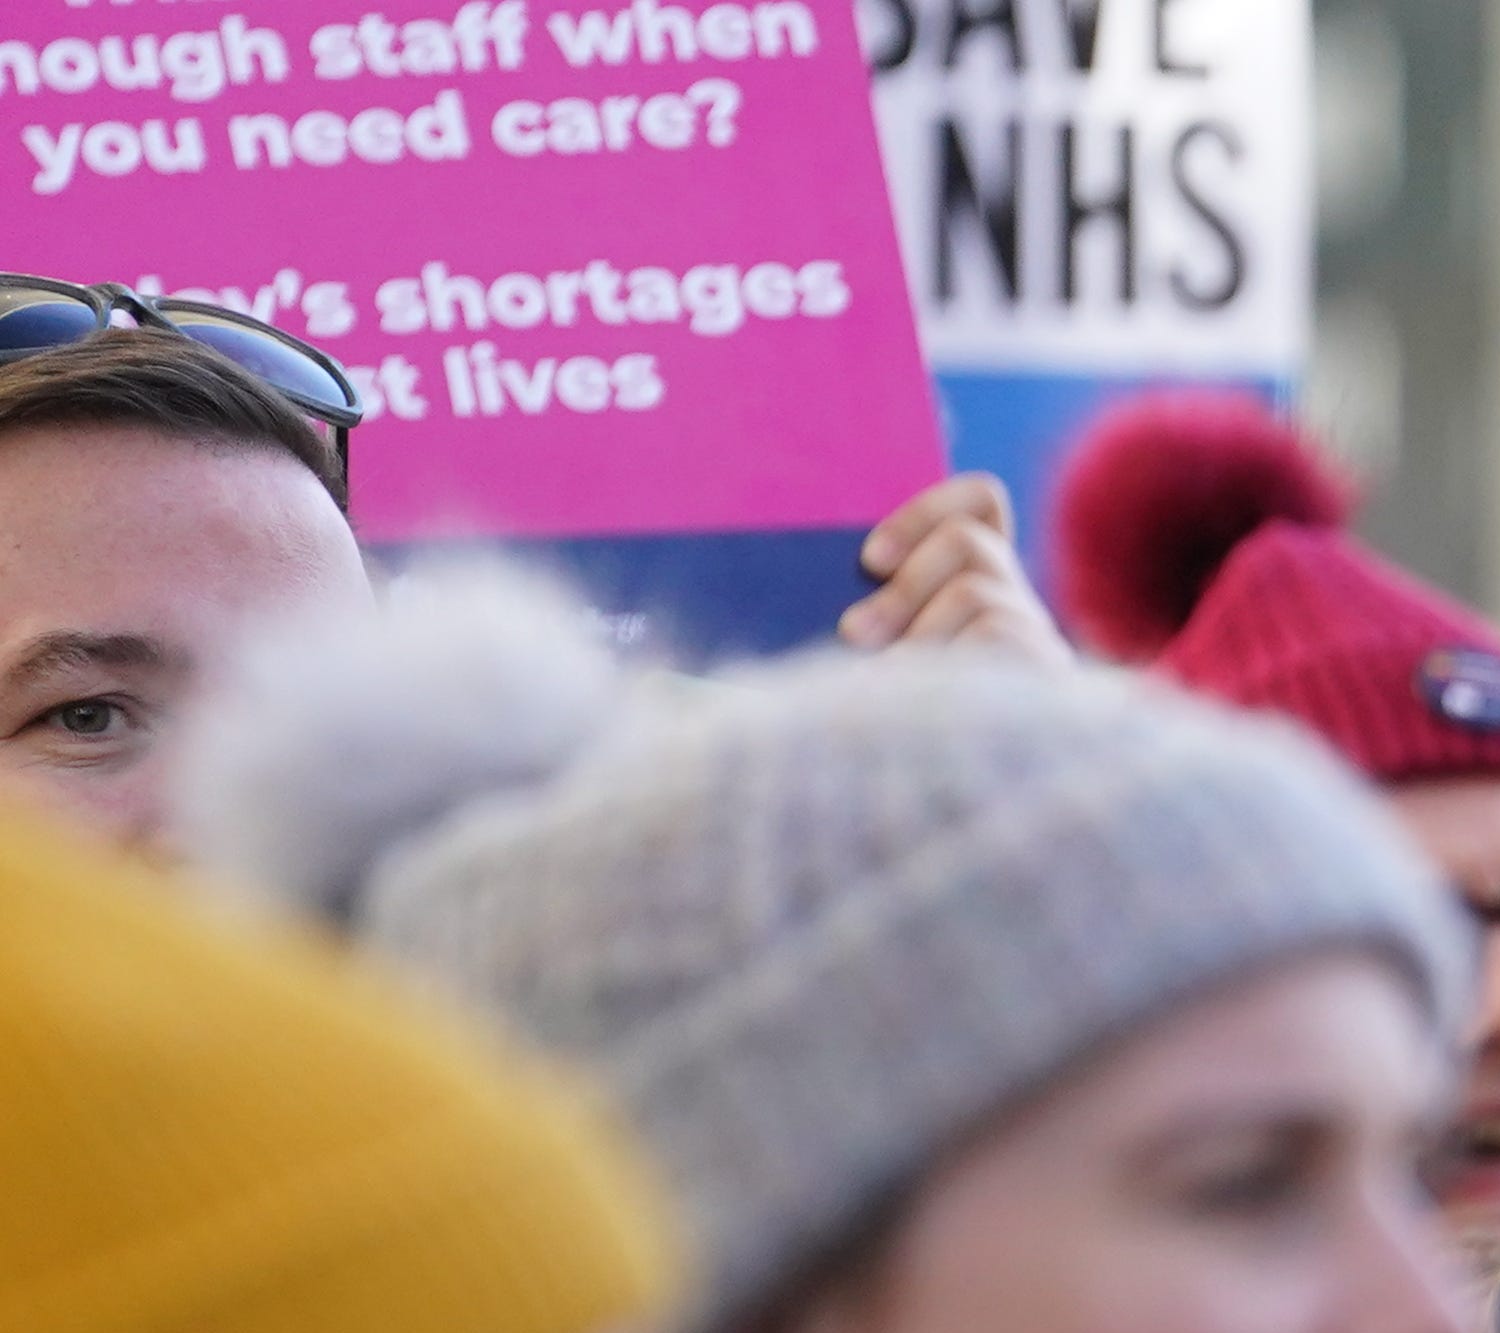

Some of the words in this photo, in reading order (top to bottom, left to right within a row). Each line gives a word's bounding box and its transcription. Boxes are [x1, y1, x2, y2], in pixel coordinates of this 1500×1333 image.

[0, 14, 289, 102] nough
[309, 0, 529, 80] staff
[547, 0, 818, 66] when
[21, 118, 207, 195] you
[227, 88, 470, 170] need
[491, 78, 742, 156] care?
[930, 115, 1246, 311] NHS
[375, 259, 849, 336] shortages
[442, 340, 666, 418] lives
